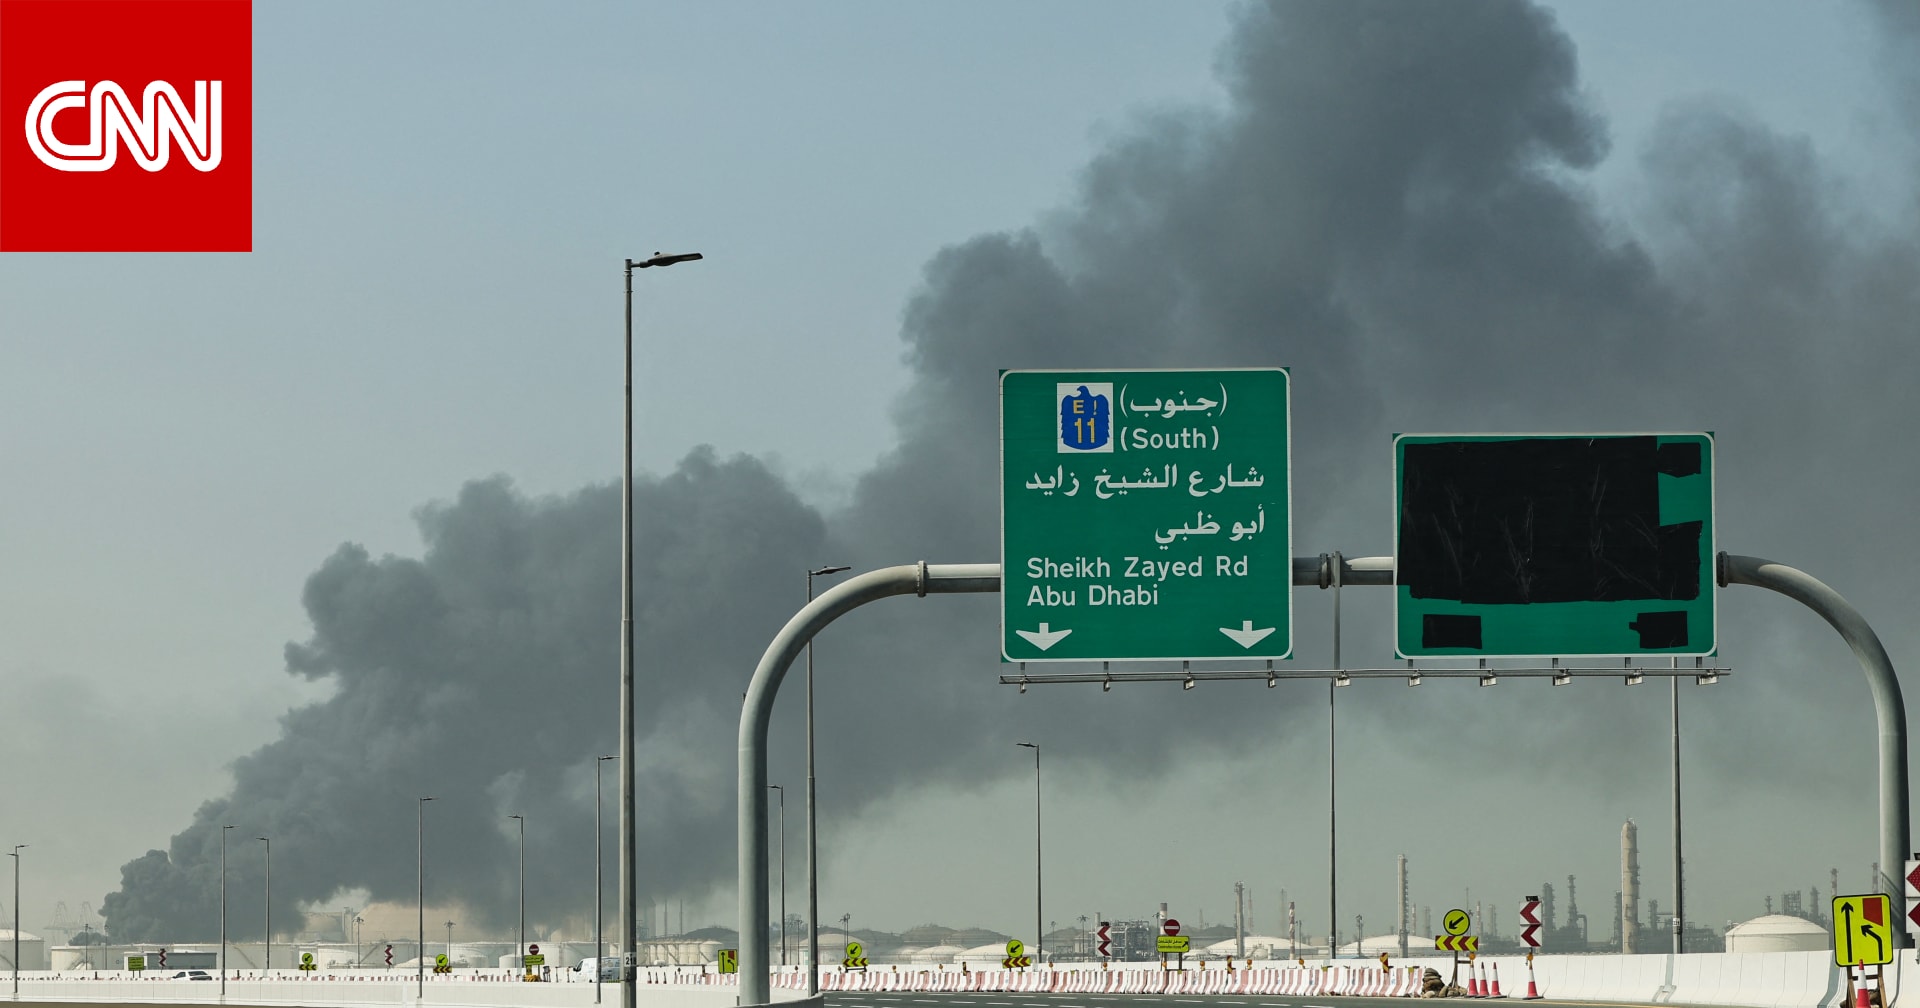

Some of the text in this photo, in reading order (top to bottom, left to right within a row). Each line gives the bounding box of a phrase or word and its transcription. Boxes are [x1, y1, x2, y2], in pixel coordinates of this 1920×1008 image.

[1073, 400, 1084, 414] E
[1075, 418, 1095, 443] 11
[1121, 426, 1218, 451] (South)
[1026, 464, 1264, 499] شارع الشيخ زايد
[1155, 504, 1264, 550] أبو ظبي
[1027, 556, 1247, 581] Sheikh Zayed Rd
[1027, 584, 1157, 606] Abu Dhabi
